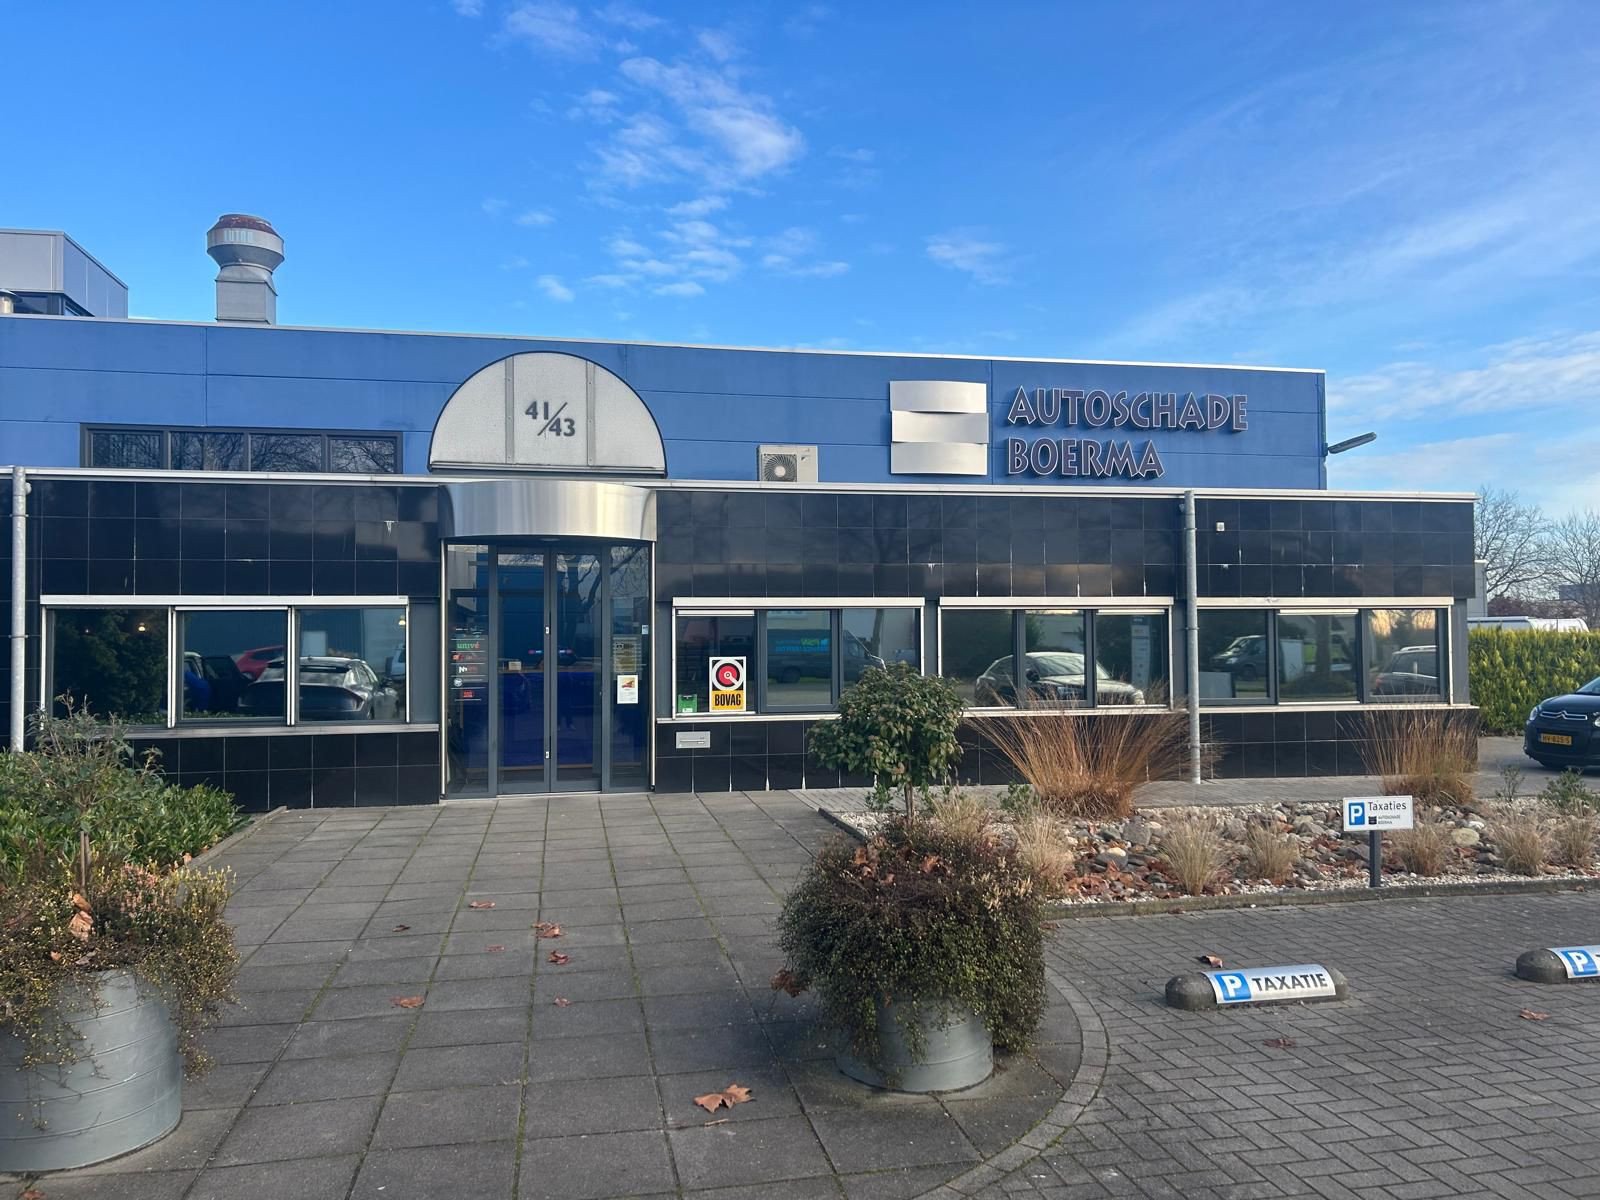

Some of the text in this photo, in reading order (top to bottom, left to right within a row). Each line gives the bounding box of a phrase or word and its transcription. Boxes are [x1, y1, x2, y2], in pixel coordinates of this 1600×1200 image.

[1007, 385, 1248, 431] AUTOSCHADE
[1008, 437, 1165, 478] BOERMA
[714, 693, 741, 707] BOVAG
[1350, 801, 1407, 823] P Taxaties
[1567, 951, 1589, 973] P
[1221, 973, 1328, 997] P TAXATIE
